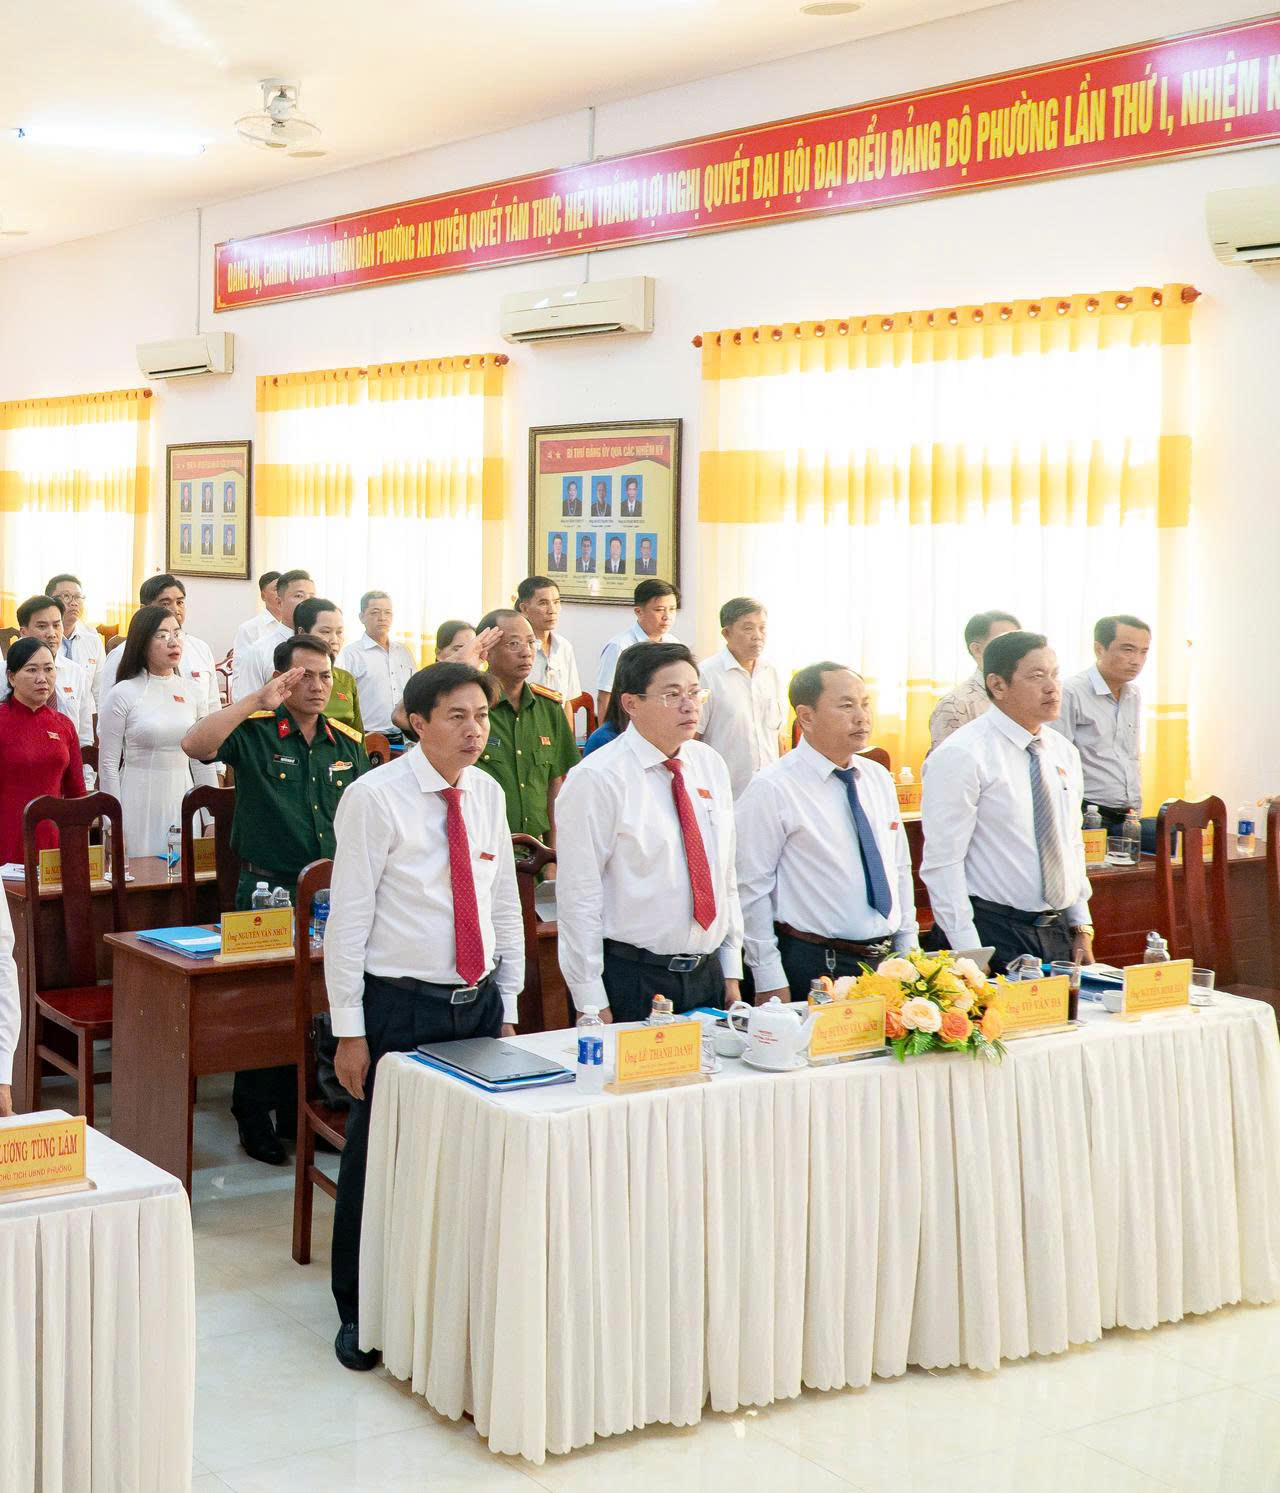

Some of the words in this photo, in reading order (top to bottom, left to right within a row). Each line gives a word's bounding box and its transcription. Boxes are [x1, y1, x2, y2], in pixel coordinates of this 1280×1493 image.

[330, 231, 355, 274] NHÂN
[356, 226, 375, 269] DÂN
[376, 217, 415, 266] PHƯỜNG
[417, 221, 431, 259] AN
[433, 207, 467, 257] XUYÊN
[470, 193, 503, 253] QUYẾT
[505, 195, 529, 242] TÂM
[532, 192, 561, 245] THỰC
[565, 182, 593, 239] HIỆN
[597, 169, 638, 227] THẮNG
[642, 171, 663, 226] LỢI
[666, 168, 700, 220] NGHỊ
[704, 143, 750, 213] QUYẾT
[753, 154, 779, 208] ĐẠI
[784, 137, 810, 203] HỘI
[814, 140, 843, 198] ĐẠI
[846, 114, 887, 184] BIỂU
[891, 105, 941, 176] ĐẢNG
[946, 105, 972, 176] BỘ
[977, 90, 1058, 162] PHƯỜNG
[1064, 73, 1107, 147] LẦN
[1112, 64, 1158, 136] THỨ
[1160, 77, 1174, 136] I,
[1180, 51, 1261, 132] NHIỆM
[31, 1132, 55, 1160] TÙNG
[58, 1130, 78, 1156] LÂM
[29, 1167, 45, 1177] UBND
